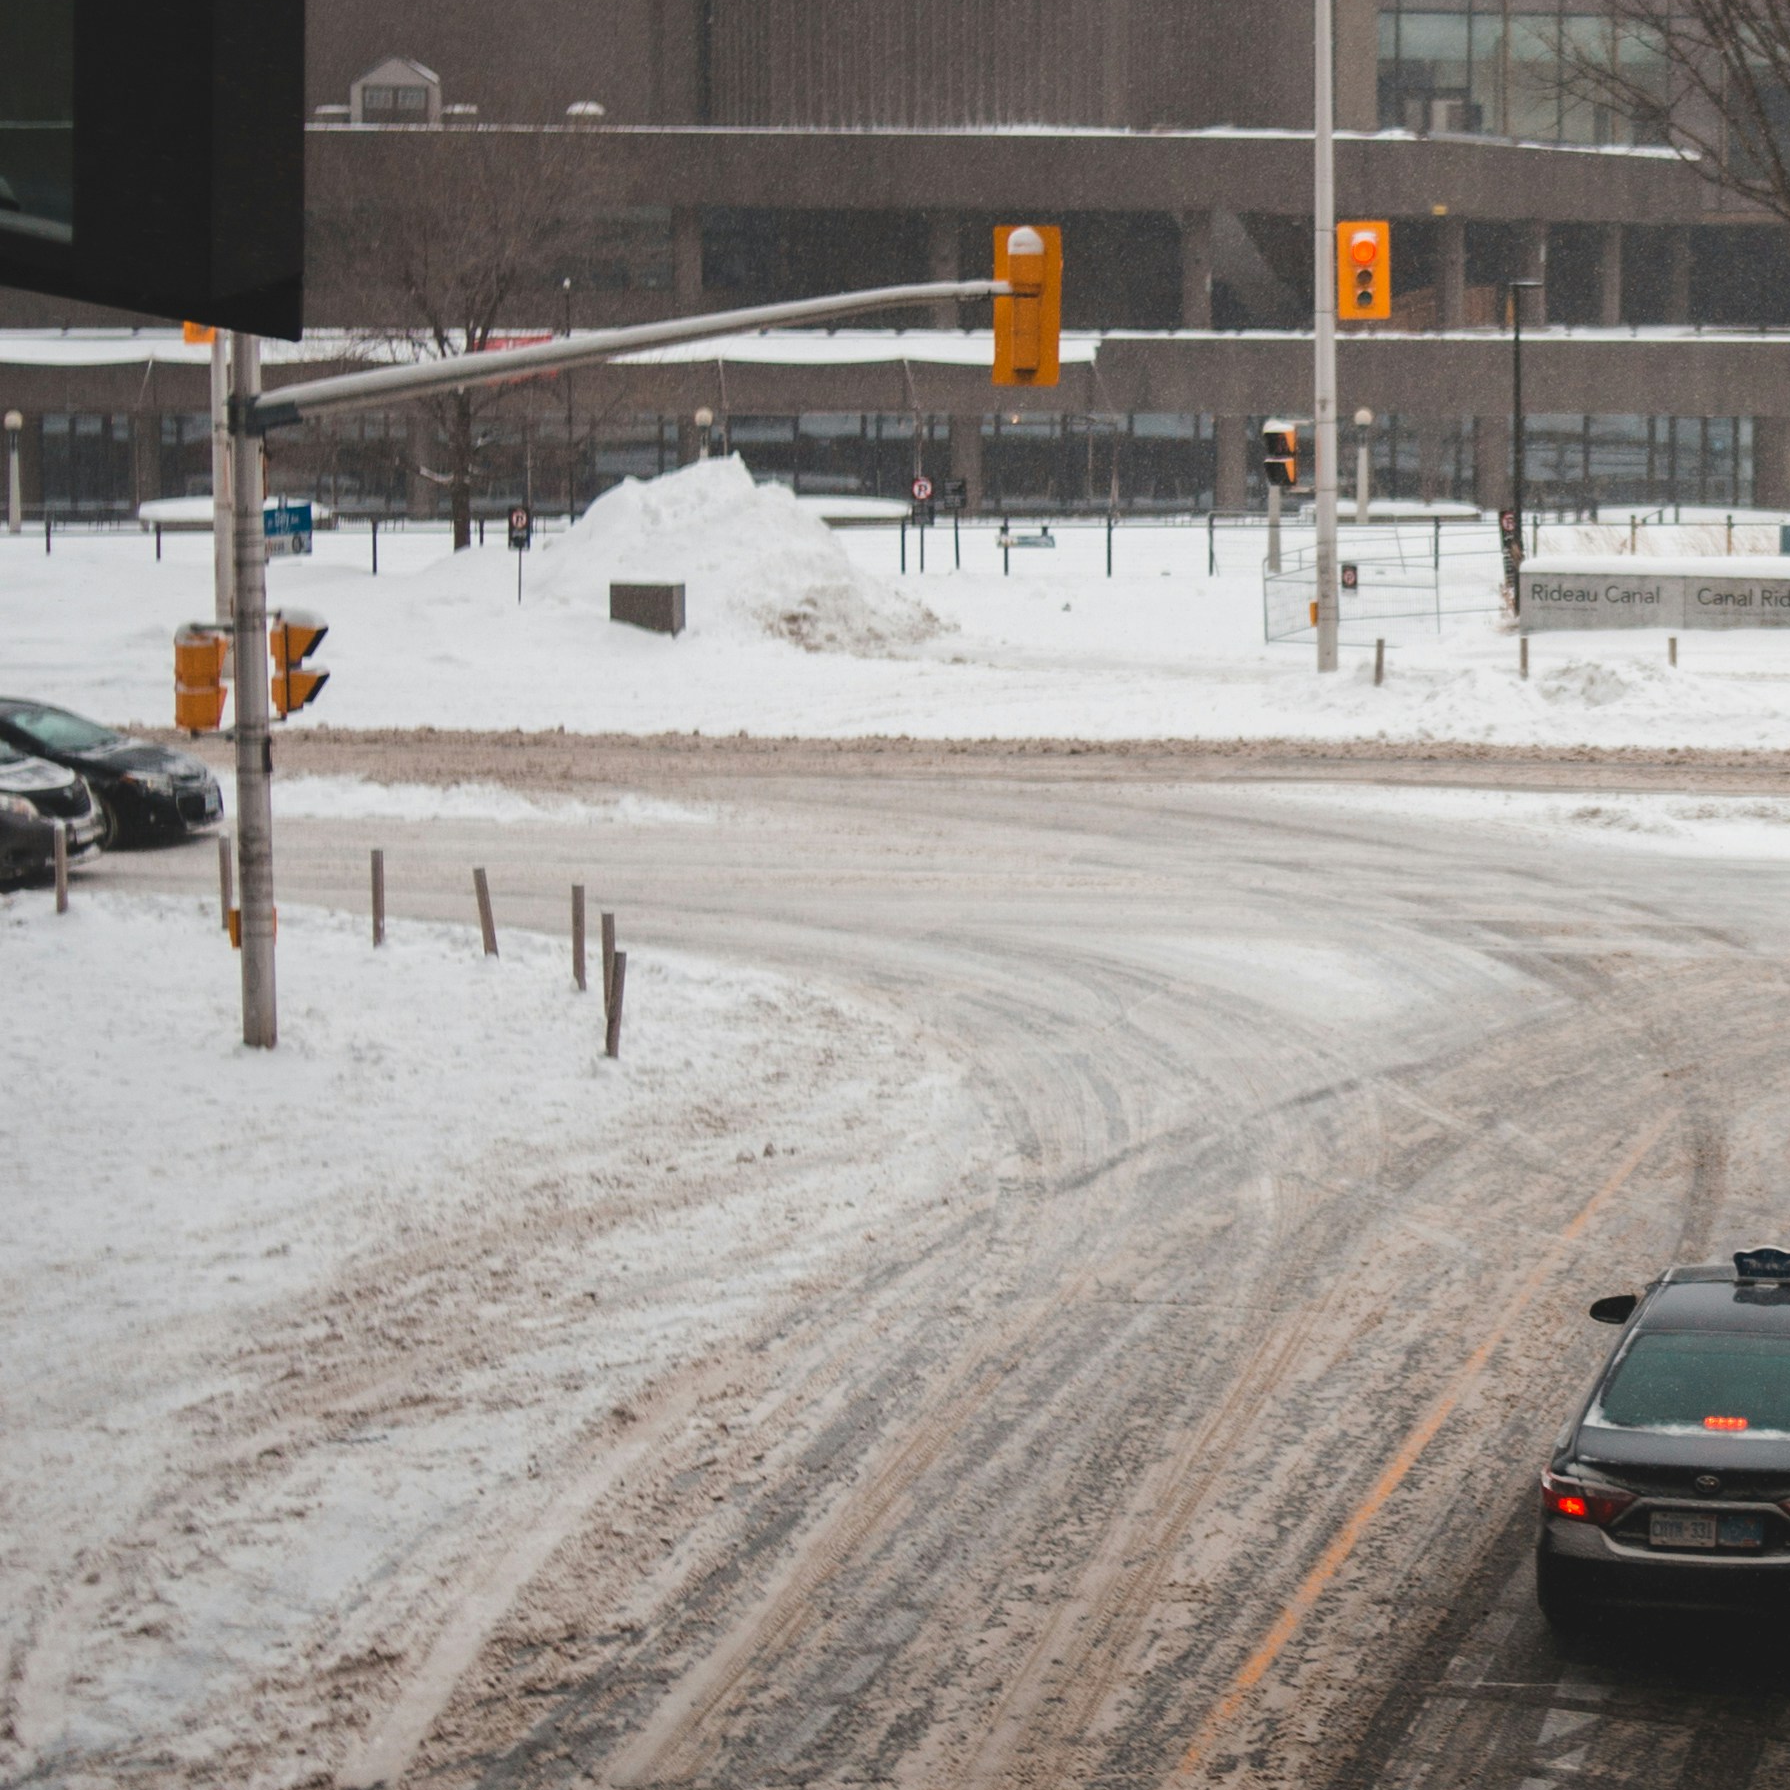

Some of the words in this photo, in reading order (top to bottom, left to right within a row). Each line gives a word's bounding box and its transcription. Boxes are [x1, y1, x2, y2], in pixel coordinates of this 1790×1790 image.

[1531, 583, 1598, 603] Rideau
[1605, 585, 1661, 604] Canal
[1697, 587, 1753, 607] Canal
